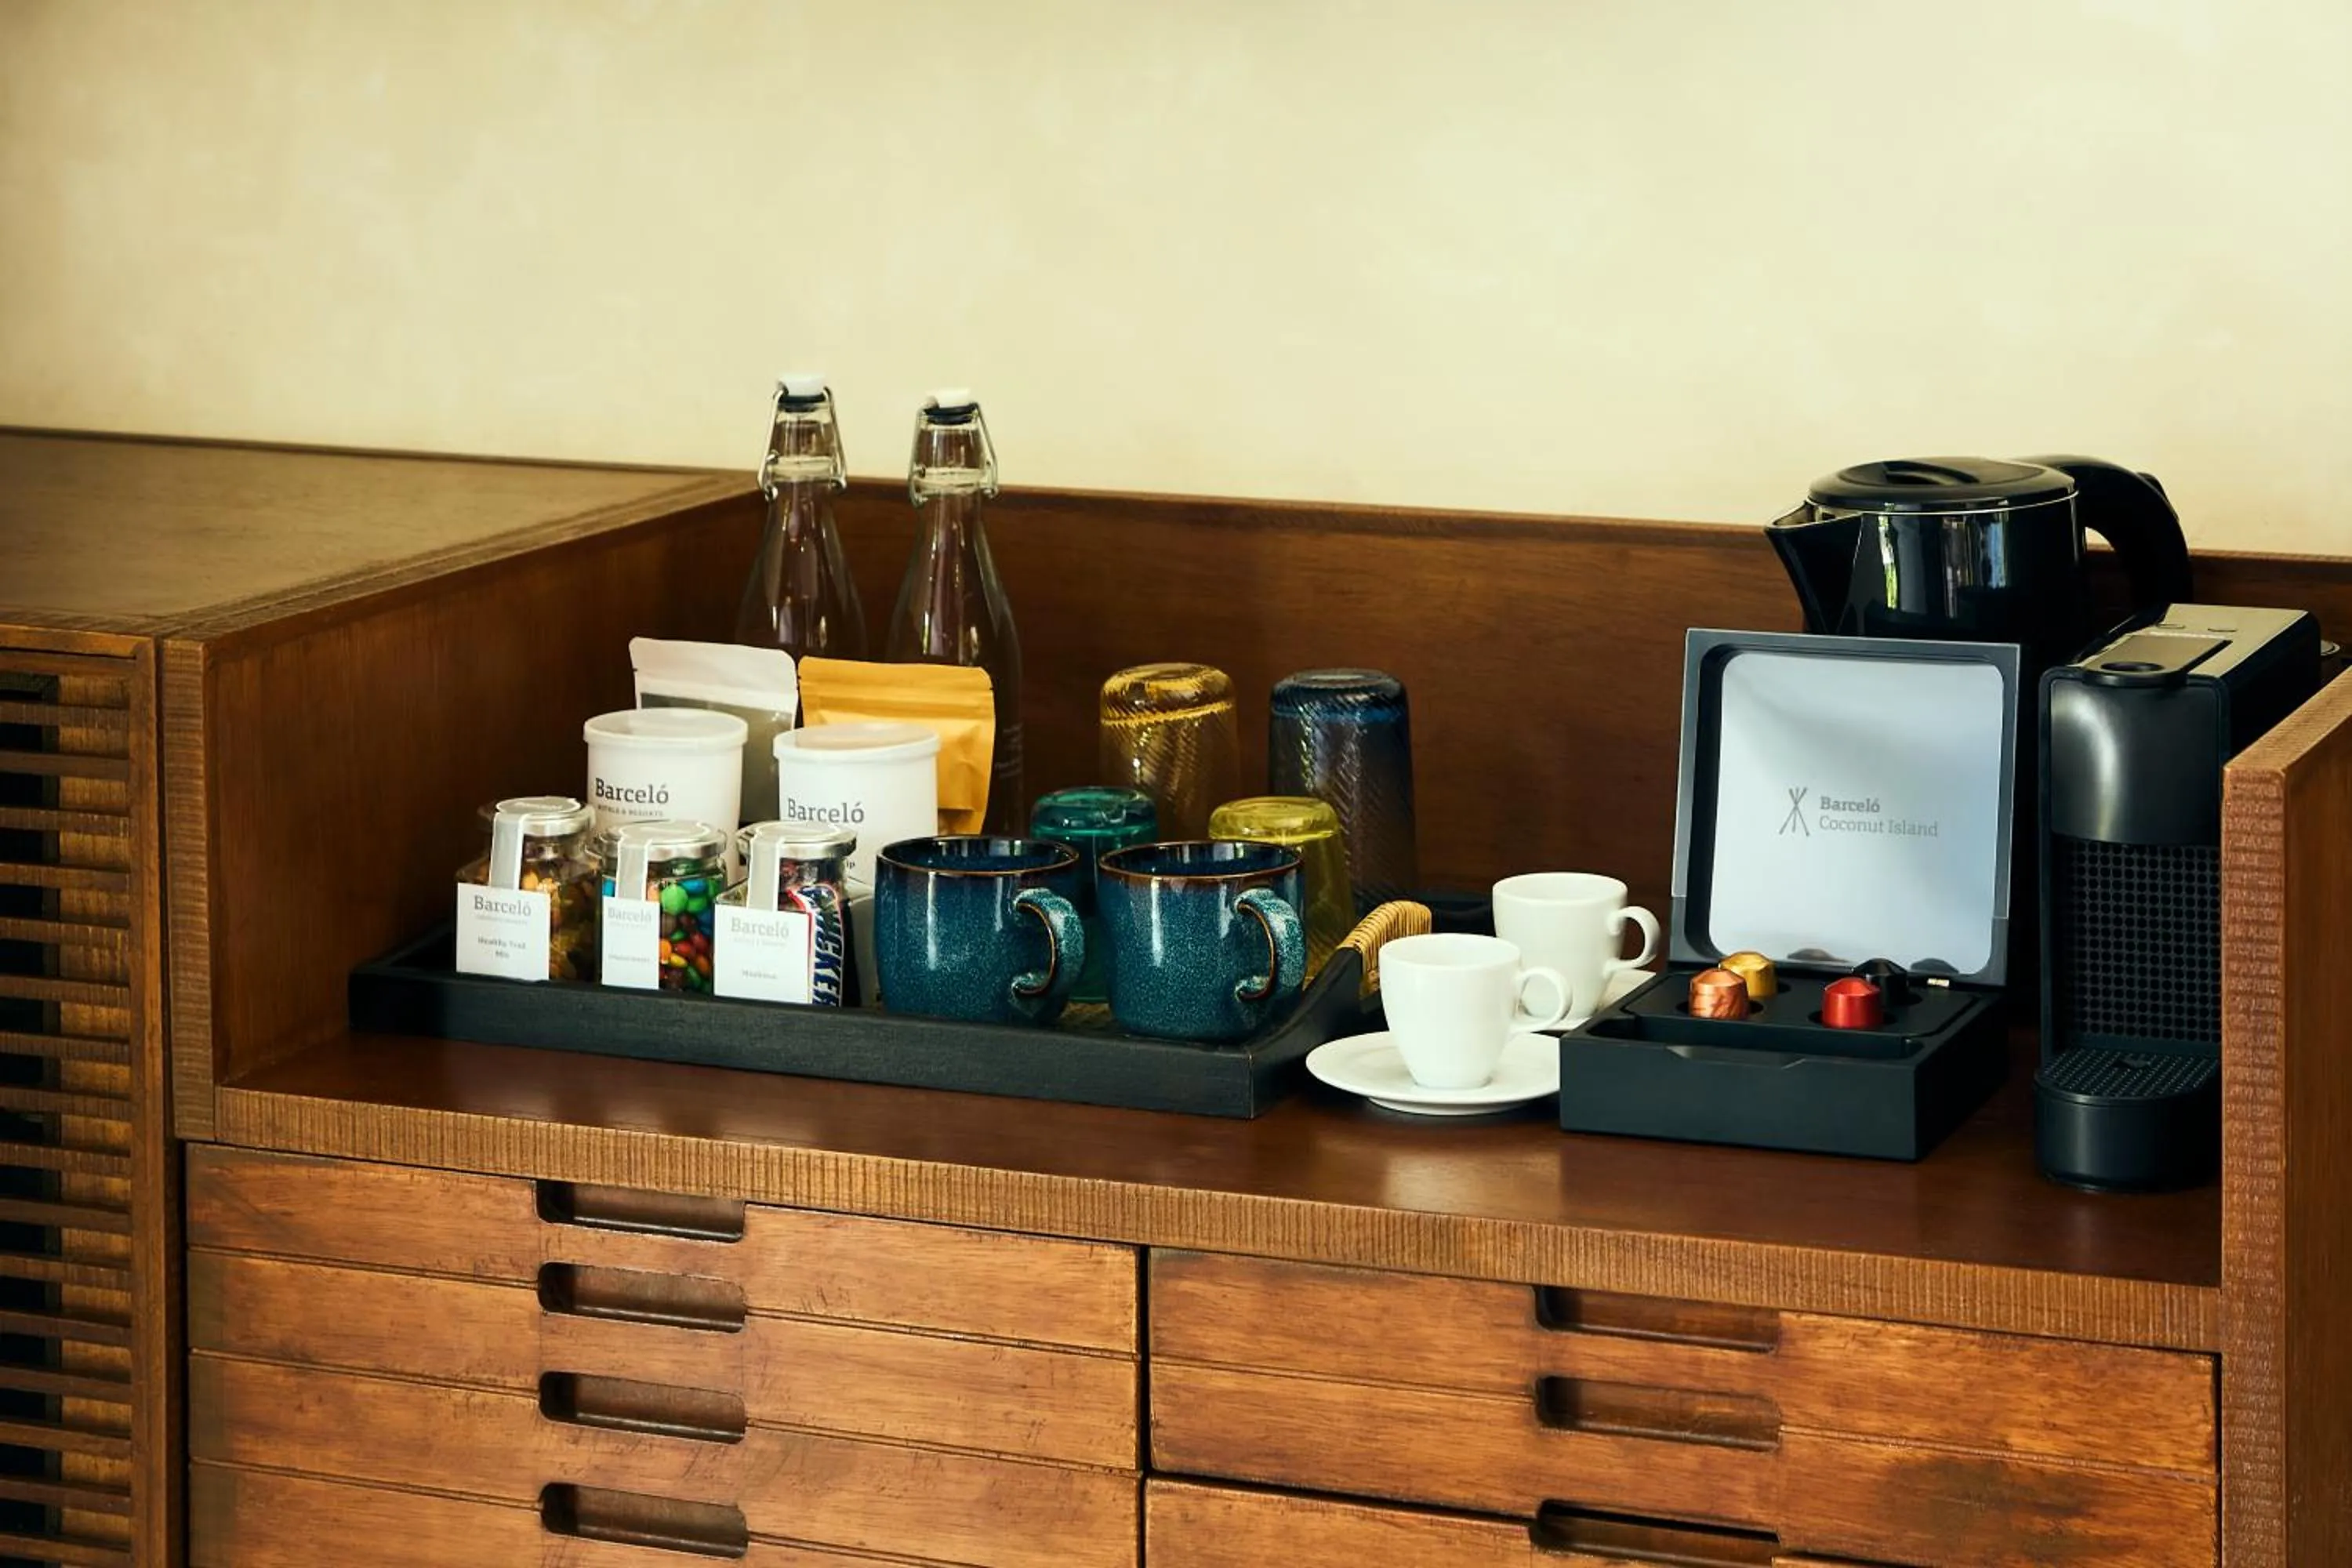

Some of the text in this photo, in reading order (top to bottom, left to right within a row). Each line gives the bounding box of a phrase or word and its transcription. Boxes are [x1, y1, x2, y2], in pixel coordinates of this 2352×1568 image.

[595, 777, 670, 804] Barceló
[787, 797, 865, 824] Barceló
[1820, 796, 1881, 813] Barceló
[1820, 815, 1938, 837] Coconut Island
[474, 894, 532, 917] Barceló
[731, 915, 789, 939] Barceló
